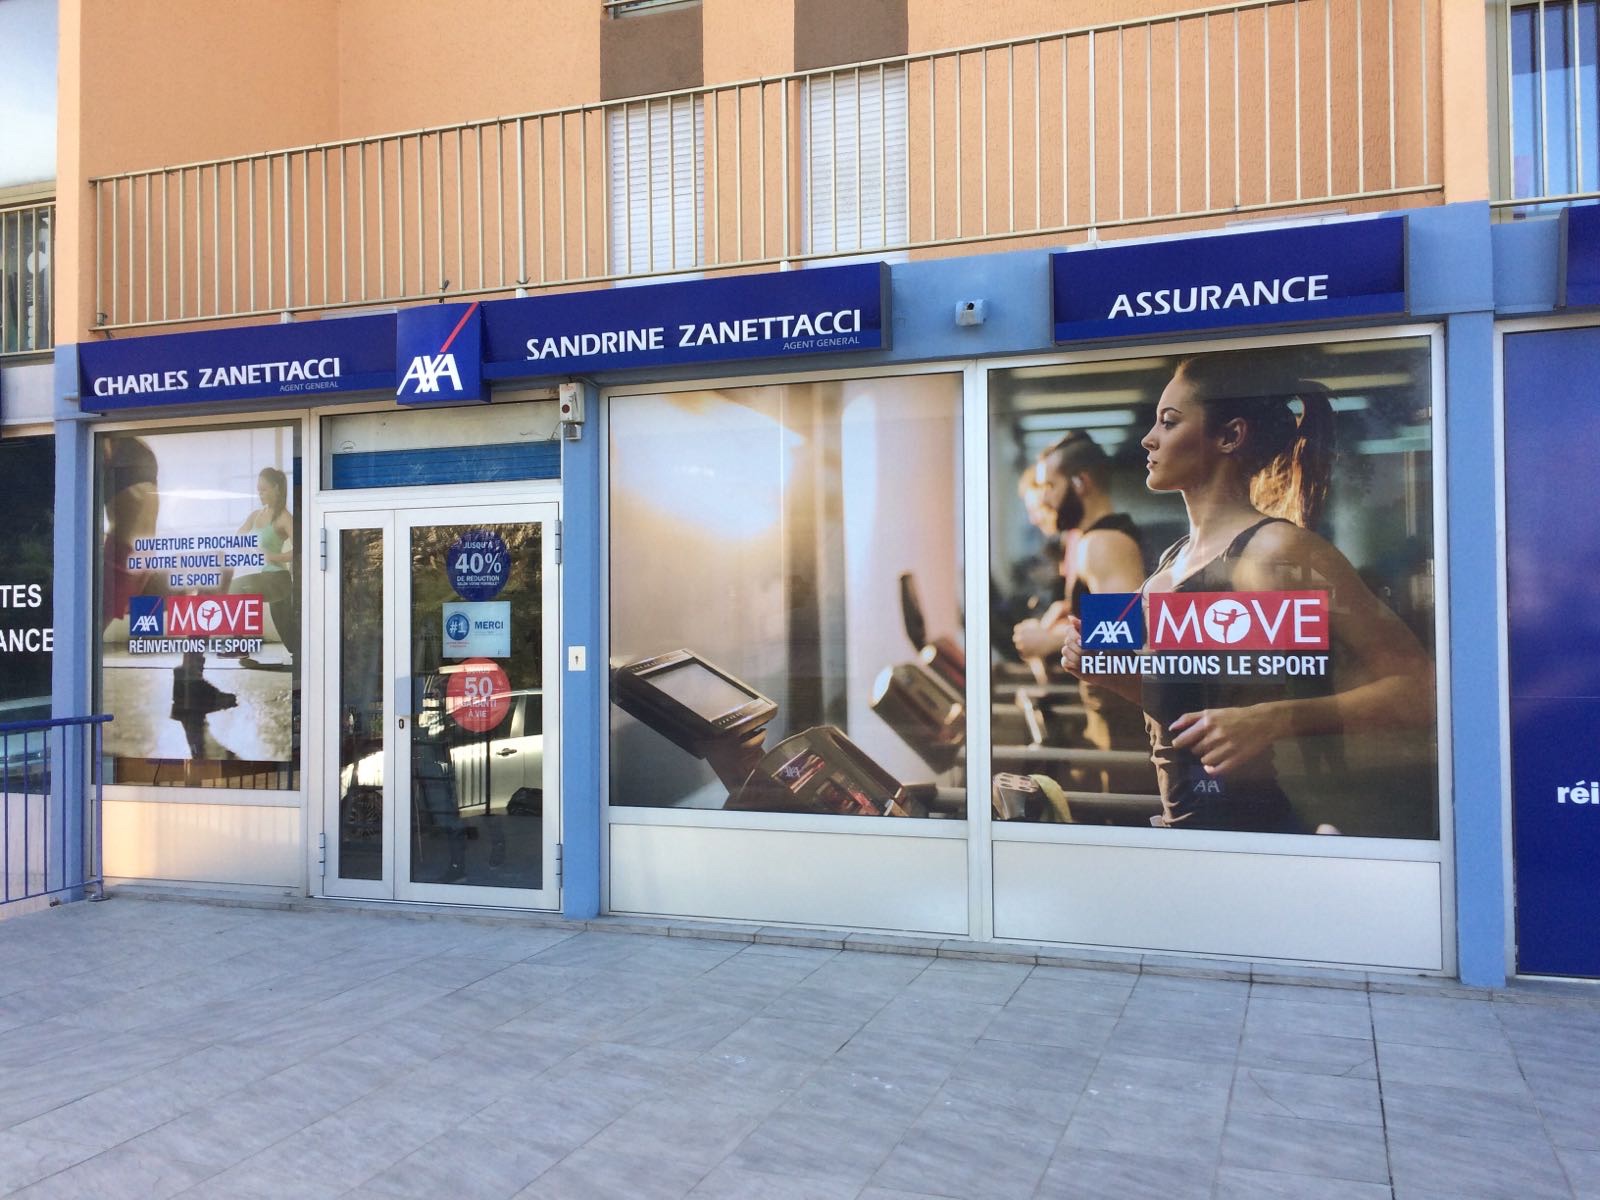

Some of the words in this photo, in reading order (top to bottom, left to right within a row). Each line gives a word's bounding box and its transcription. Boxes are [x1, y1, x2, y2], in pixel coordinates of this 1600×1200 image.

[1107, 274, 1329, 320] ASSURANCE
[526, 327, 665, 361] SANDRINE
[678, 309, 861, 348] ZANETTACCI
[783, 340, 814, 350] AGENT
[816, 336, 860, 347] GENERAL
[94, 370, 189, 396] CHARLES
[198, 357, 340, 388] ZANETTACCI
[396, 353, 464, 396] AXA
[279, 383, 304, 392] AGENT
[305, 381, 339, 390] GENERAL
[135, 537, 195, 551] OUVERTURE
[197, 535, 258, 549] PROCHAINE
[128, 557, 142, 569] DE
[144, 556, 177, 569] VOTRE
[180, 555, 221, 568] NOUVEL
[224, 553, 265, 566] ESPACE
[455, 552, 502, 574] 40%
[170, 574, 183, 586] DE
[186, 573, 222, 586] SPORT
[0, 584, 42, 608] TES
[131, 616, 159, 632] AXA
[170, 600, 259, 632] MOVE
[474, 621, 504, 630] MERCI
[1085, 621, 1134, 644] AXA
[1155, 599, 1321, 644] MOVE
[129, 637, 205, 653] RÉINVENTONS
[208, 639, 222, 653] LE
[225, 638, 263, 653] SPORT
[1081, 652, 1221, 676] RÉINVENTONS
[1227, 656, 1252, 675] LE
[1258, 656, 1329, 676] SPORT
[464, 676, 493, 698] 50
